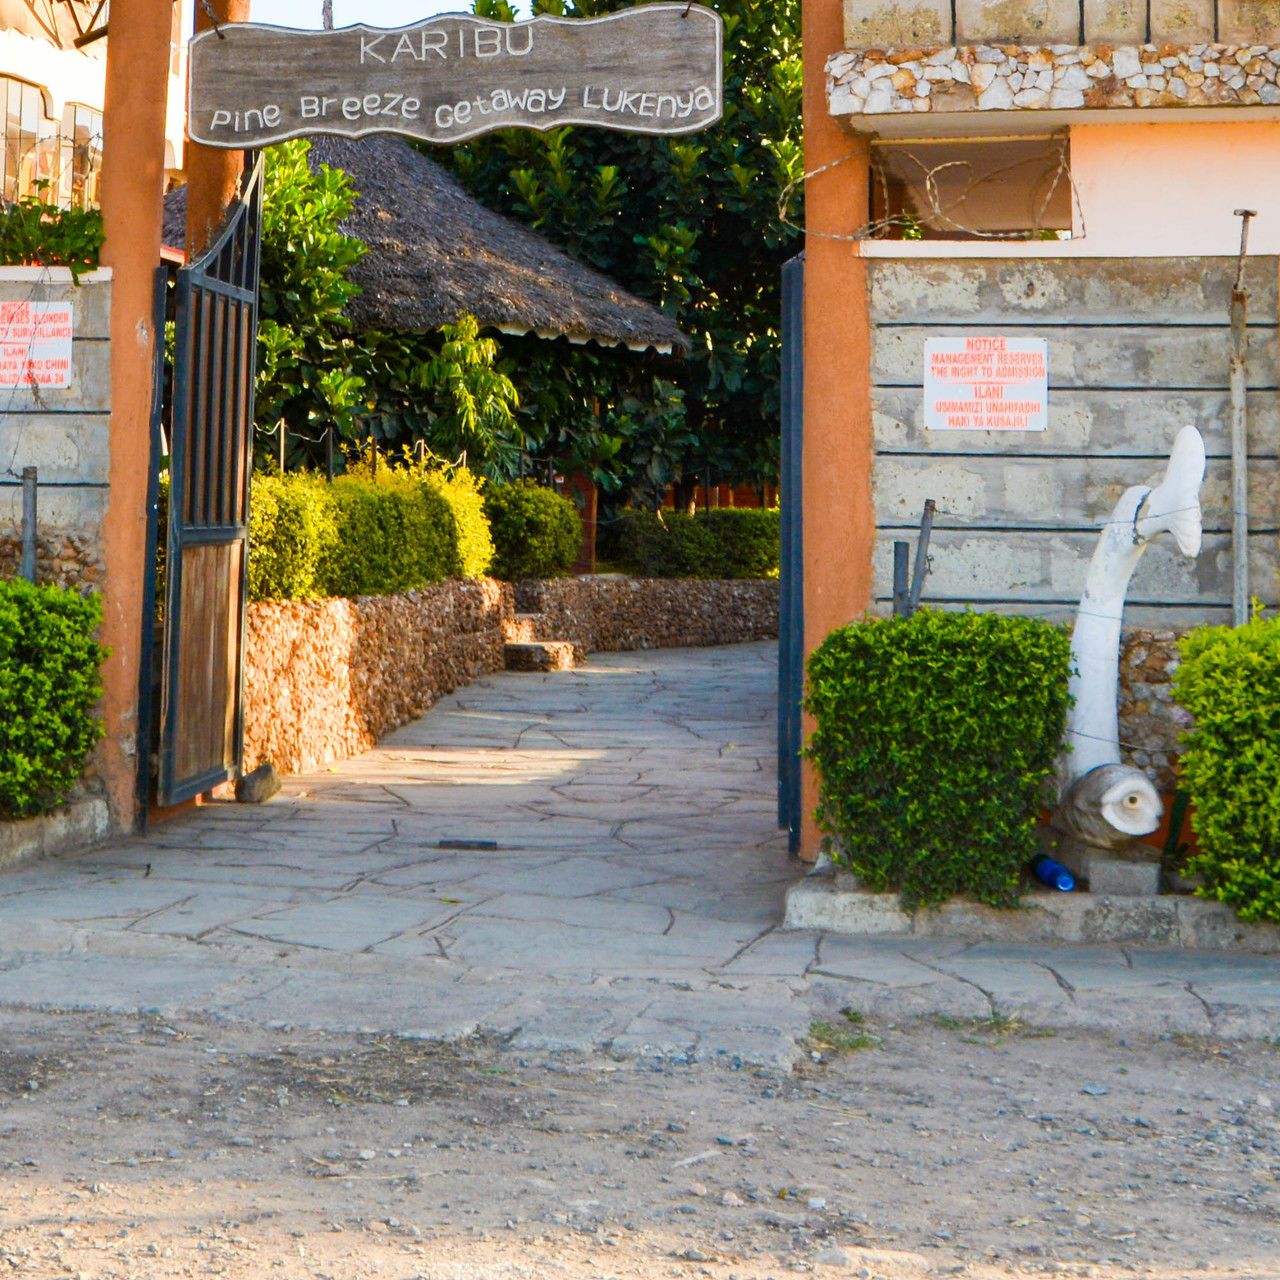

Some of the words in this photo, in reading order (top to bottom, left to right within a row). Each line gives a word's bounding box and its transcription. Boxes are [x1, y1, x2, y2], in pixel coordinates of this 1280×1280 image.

[359, 25, 535, 65] KARIBU
[209, 104, 281, 133] Pine
[966, 338, 1006, 352] NOTICE
[931, 353, 993, 365] MANAGEMENT
[996, 353, 1043, 365] RESERVES
[930, 366, 948, 377] THE
[951, 366, 978, 377] RIGHT
[981, 366, 993, 377] TO
[995, 366, 1046, 378] ADMISSION
[974, 385, 1004, 399] ILANI
[948, 415, 970, 427] HAKI
[973, 415, 984, 427] YA
